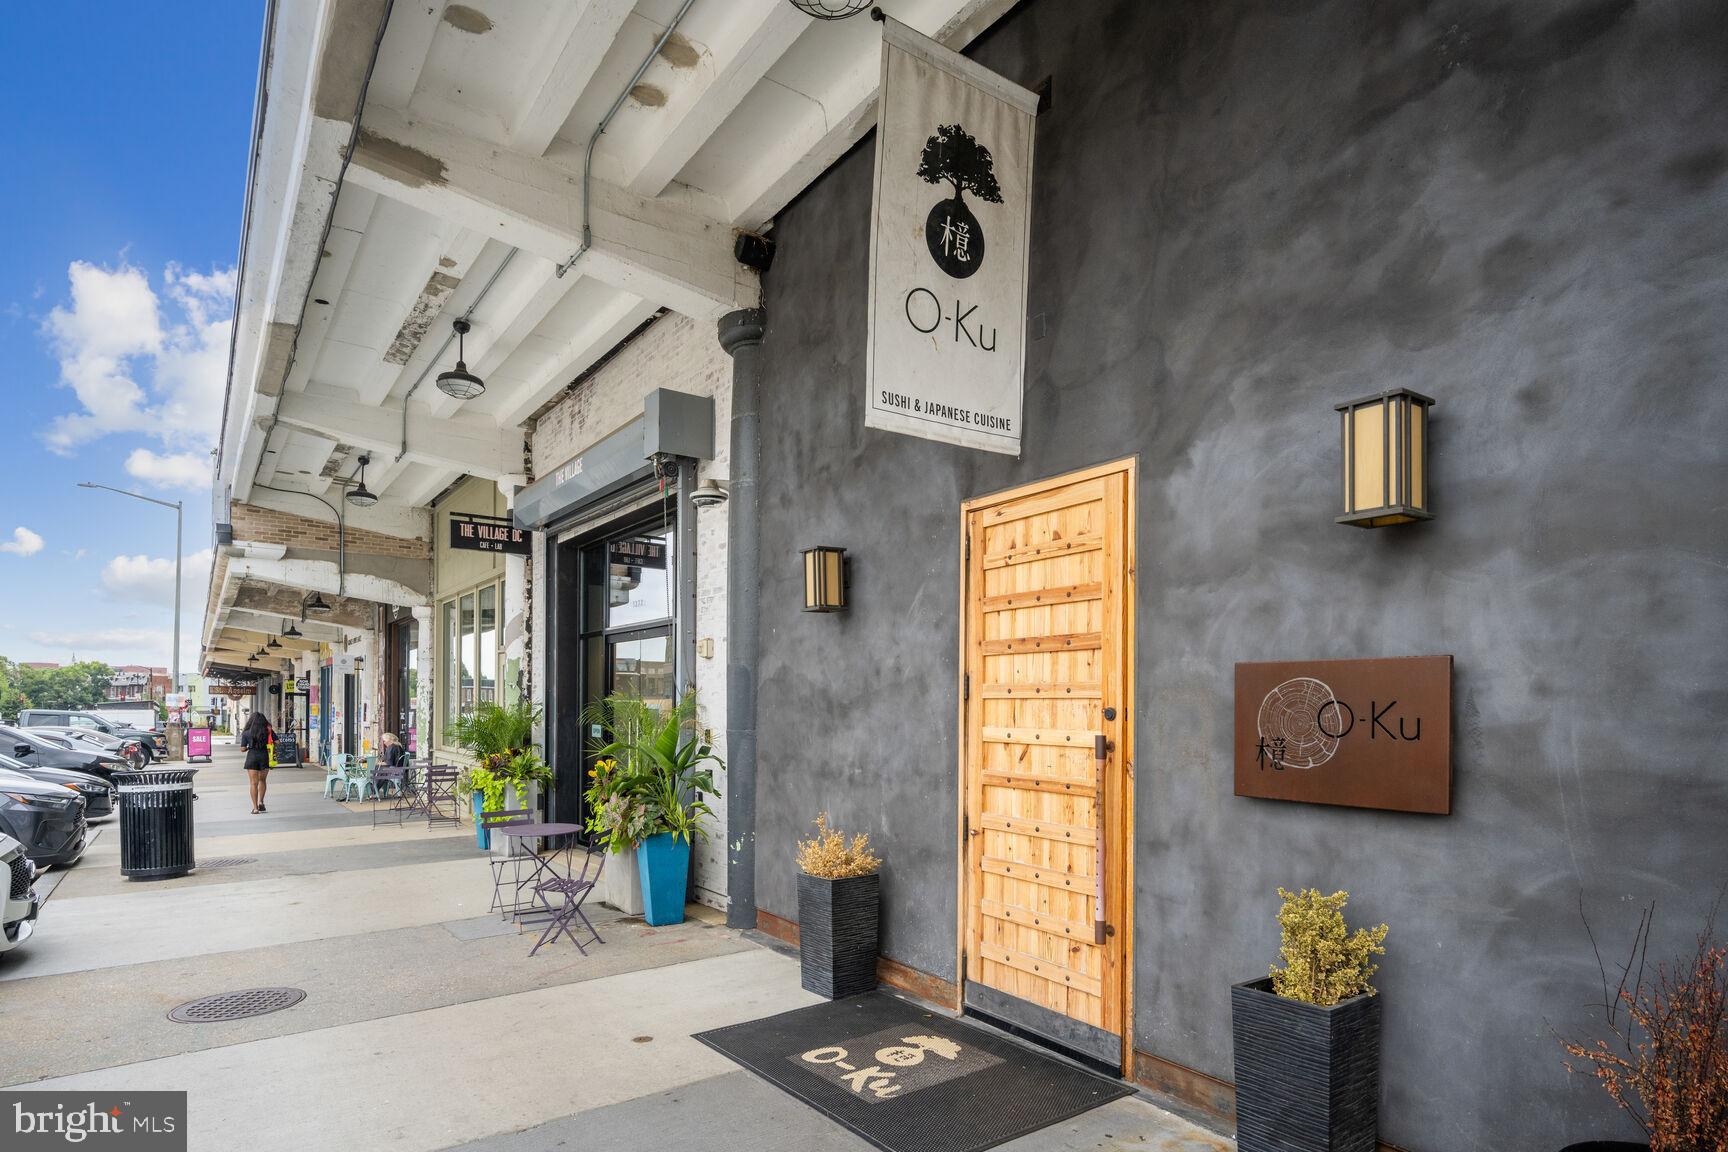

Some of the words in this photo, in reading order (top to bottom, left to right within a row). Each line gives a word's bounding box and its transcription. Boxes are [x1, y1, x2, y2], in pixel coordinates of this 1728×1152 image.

[905, 287, 996, 353] O-Ku
[881, 390, 911, 410] SUSHI
[914, 398, 922, 412] &
[924, 401, 971, 423] JAPANESE
[974, 412, 1012, 431] CUISINE
[555, 467, 565, 488] THE
[565, 457, 583, 481] VILLAGE
[459, 523, 475, 538] THE
[477, 525, 509, 542] VILLAGE
[512, 528, 523, 542] DC
[479, 541, 490, 549] CAFE
[494, 542, 503, 550] LAB
[192, 735, 207, 743] SALE
[1317, 700, 1422, 742] O-Ku
[801, 1046, 902, 1098] O-Ku
